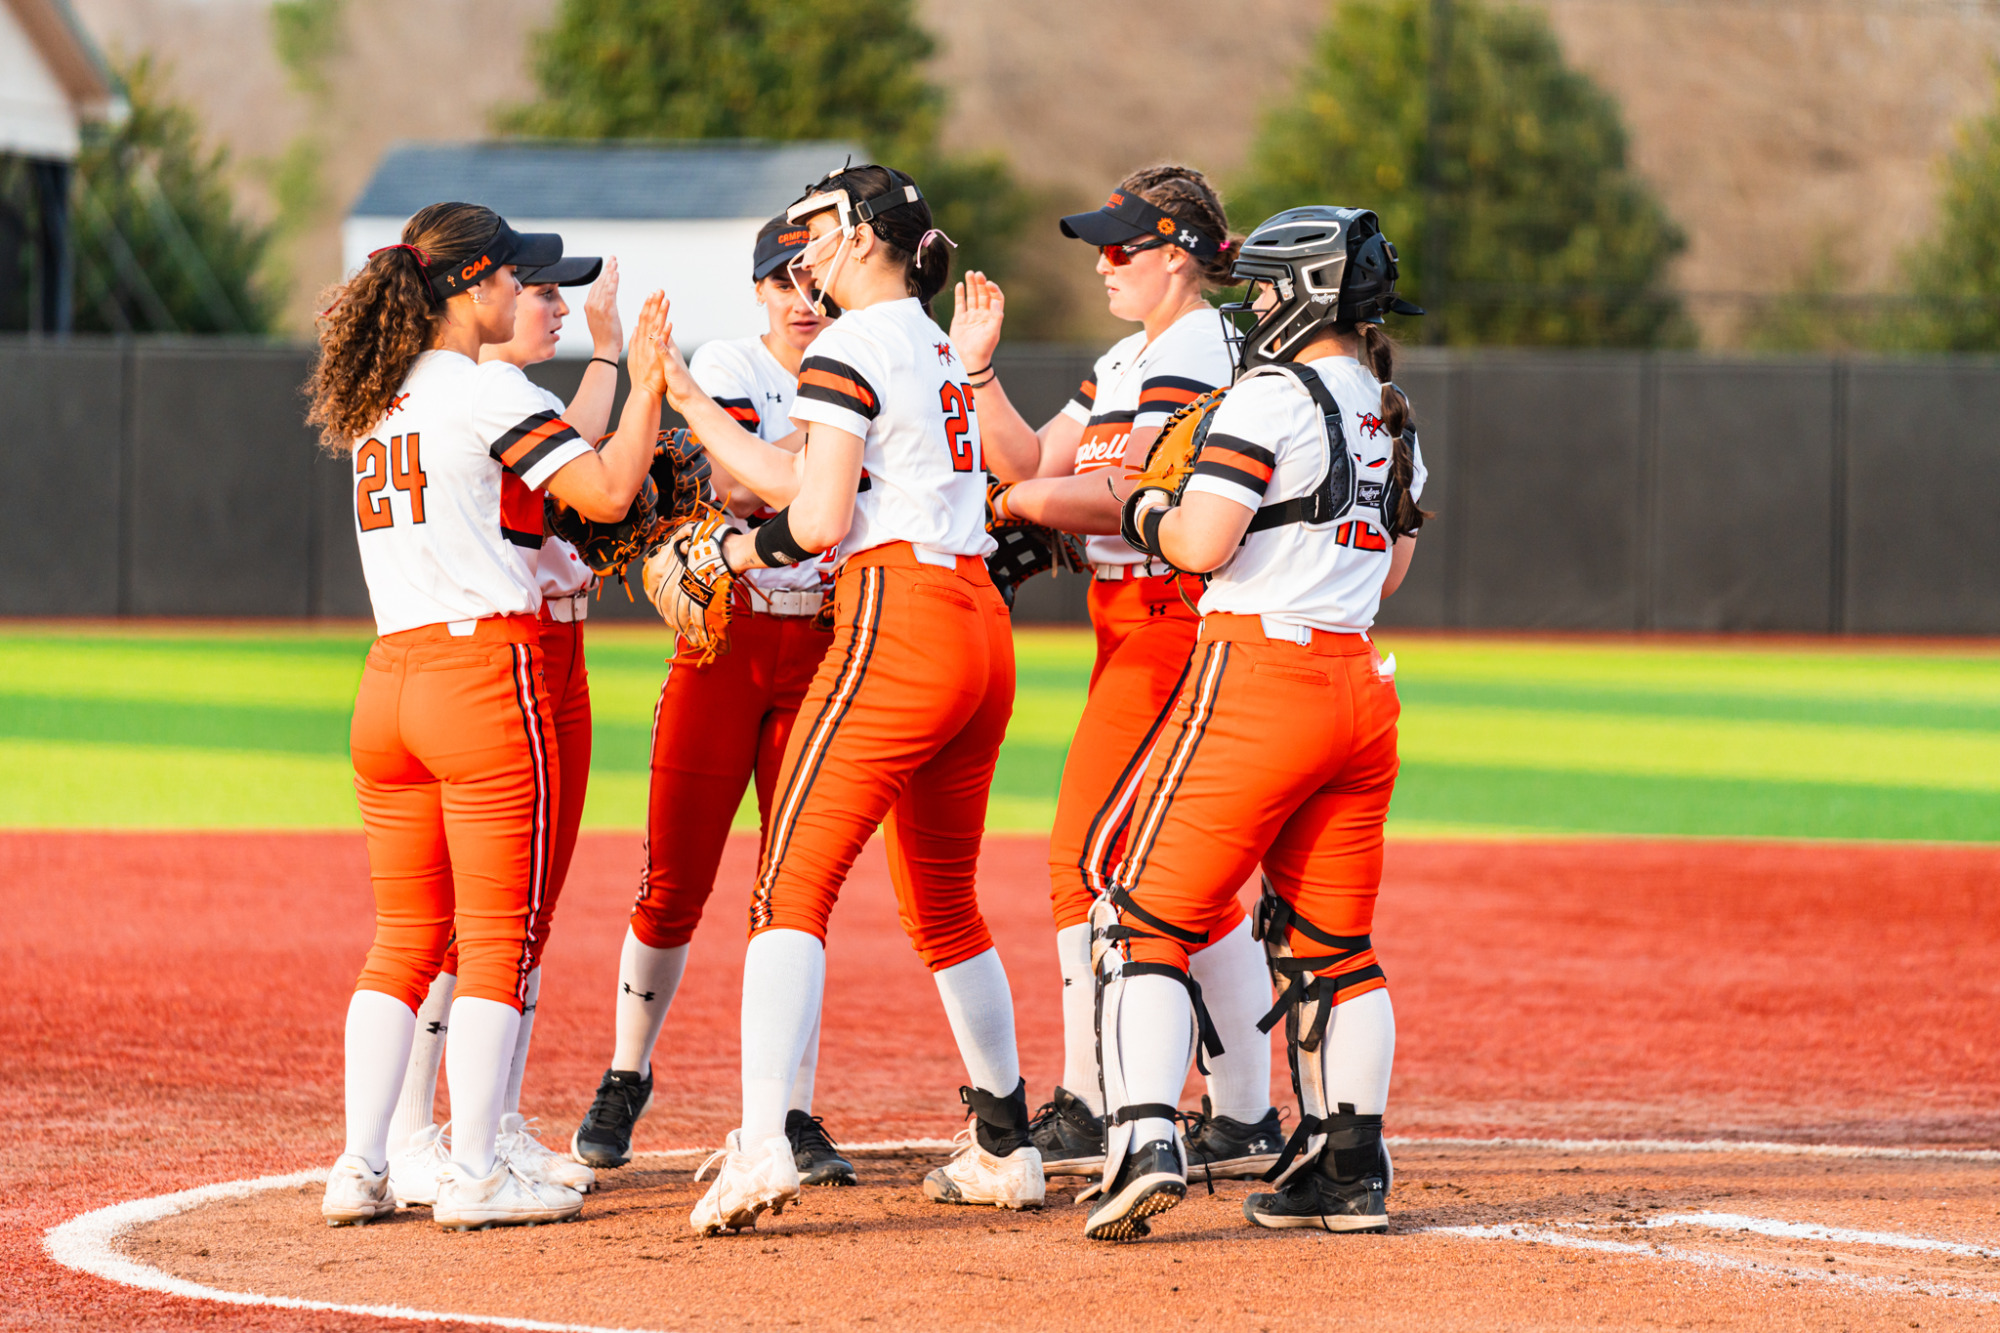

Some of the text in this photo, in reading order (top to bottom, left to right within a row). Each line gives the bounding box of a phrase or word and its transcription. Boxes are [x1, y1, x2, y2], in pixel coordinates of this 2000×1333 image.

[778, 230, 810, 244] CAMPB
[461, 254, 493, 281] CAA
[356, 432, 428, 533] 24
